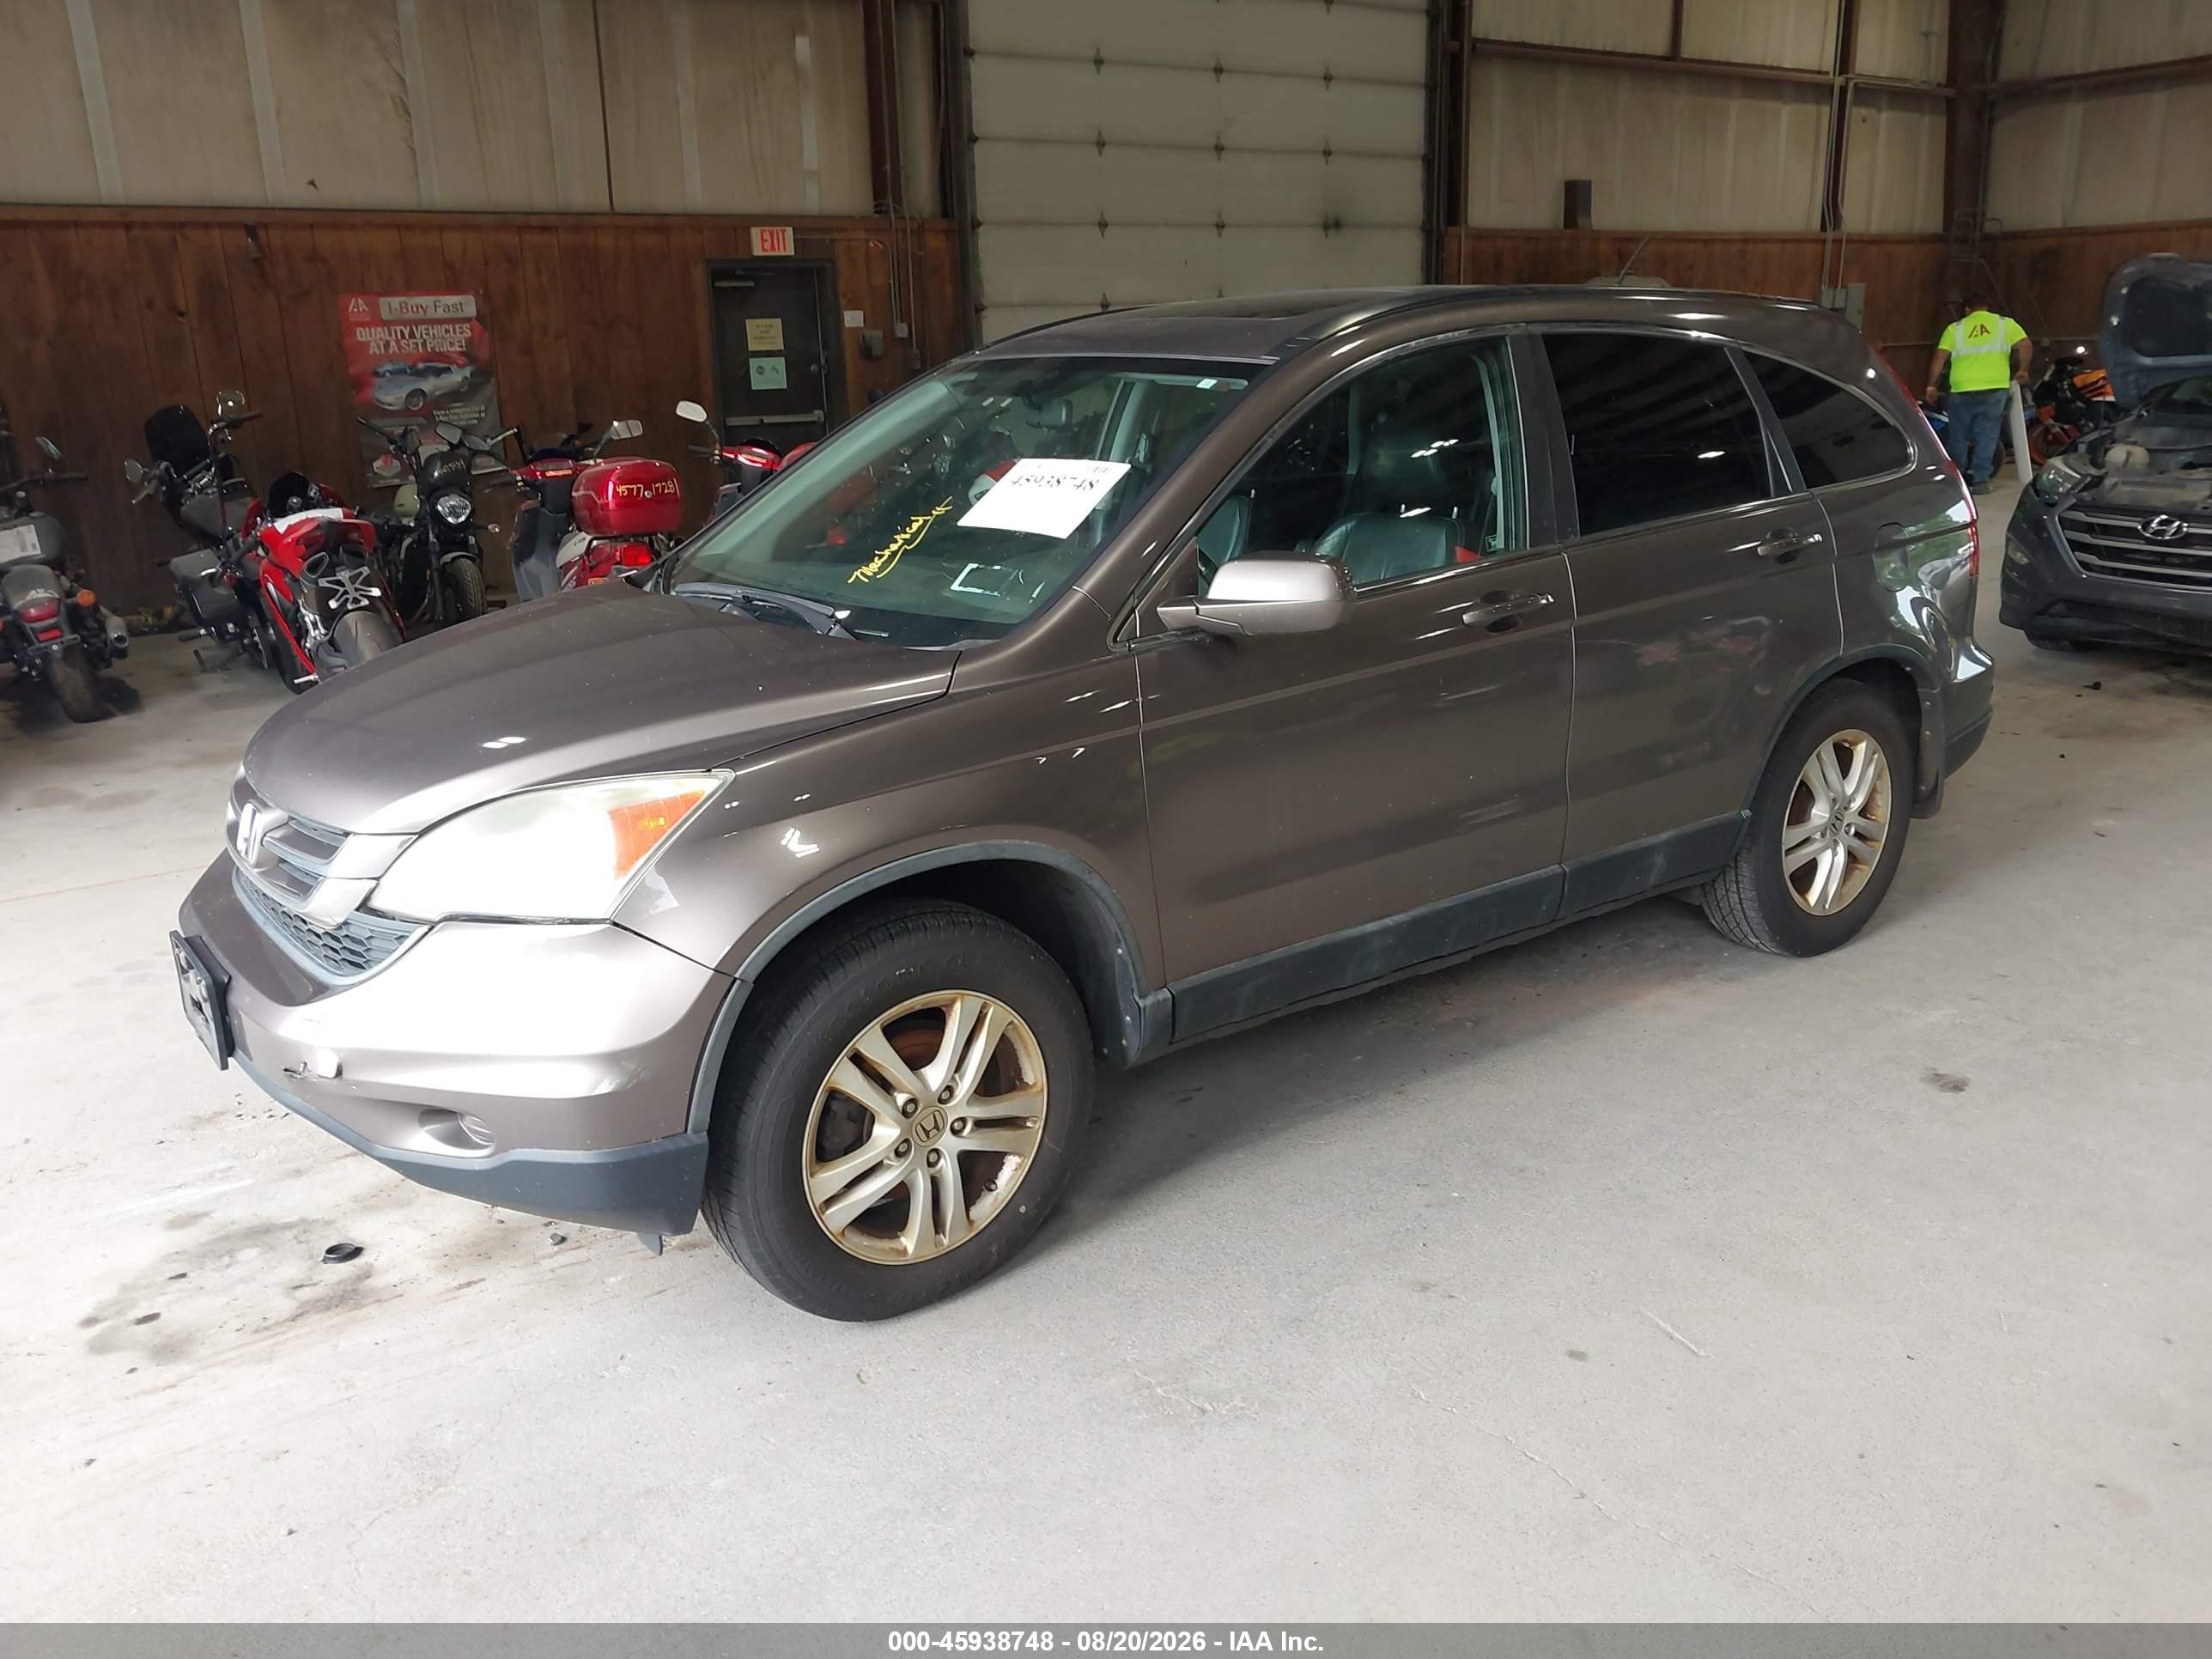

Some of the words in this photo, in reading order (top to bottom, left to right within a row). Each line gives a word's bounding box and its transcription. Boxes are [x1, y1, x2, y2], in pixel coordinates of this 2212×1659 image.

[760, 228, 787, 253] EXIT
[387, 301, 428, 317] I-Buy
[433, 300, 465, 314] Fast
[356, 325, 411, 342] QUALITY
[413, 323, 471, 340] VEHICLES
[369, 339, 386, 355] AT
[388, 339, 399, 354] A
[401, 338, 424, 354] SET
[426, 337, 466, 353] PRICE!
